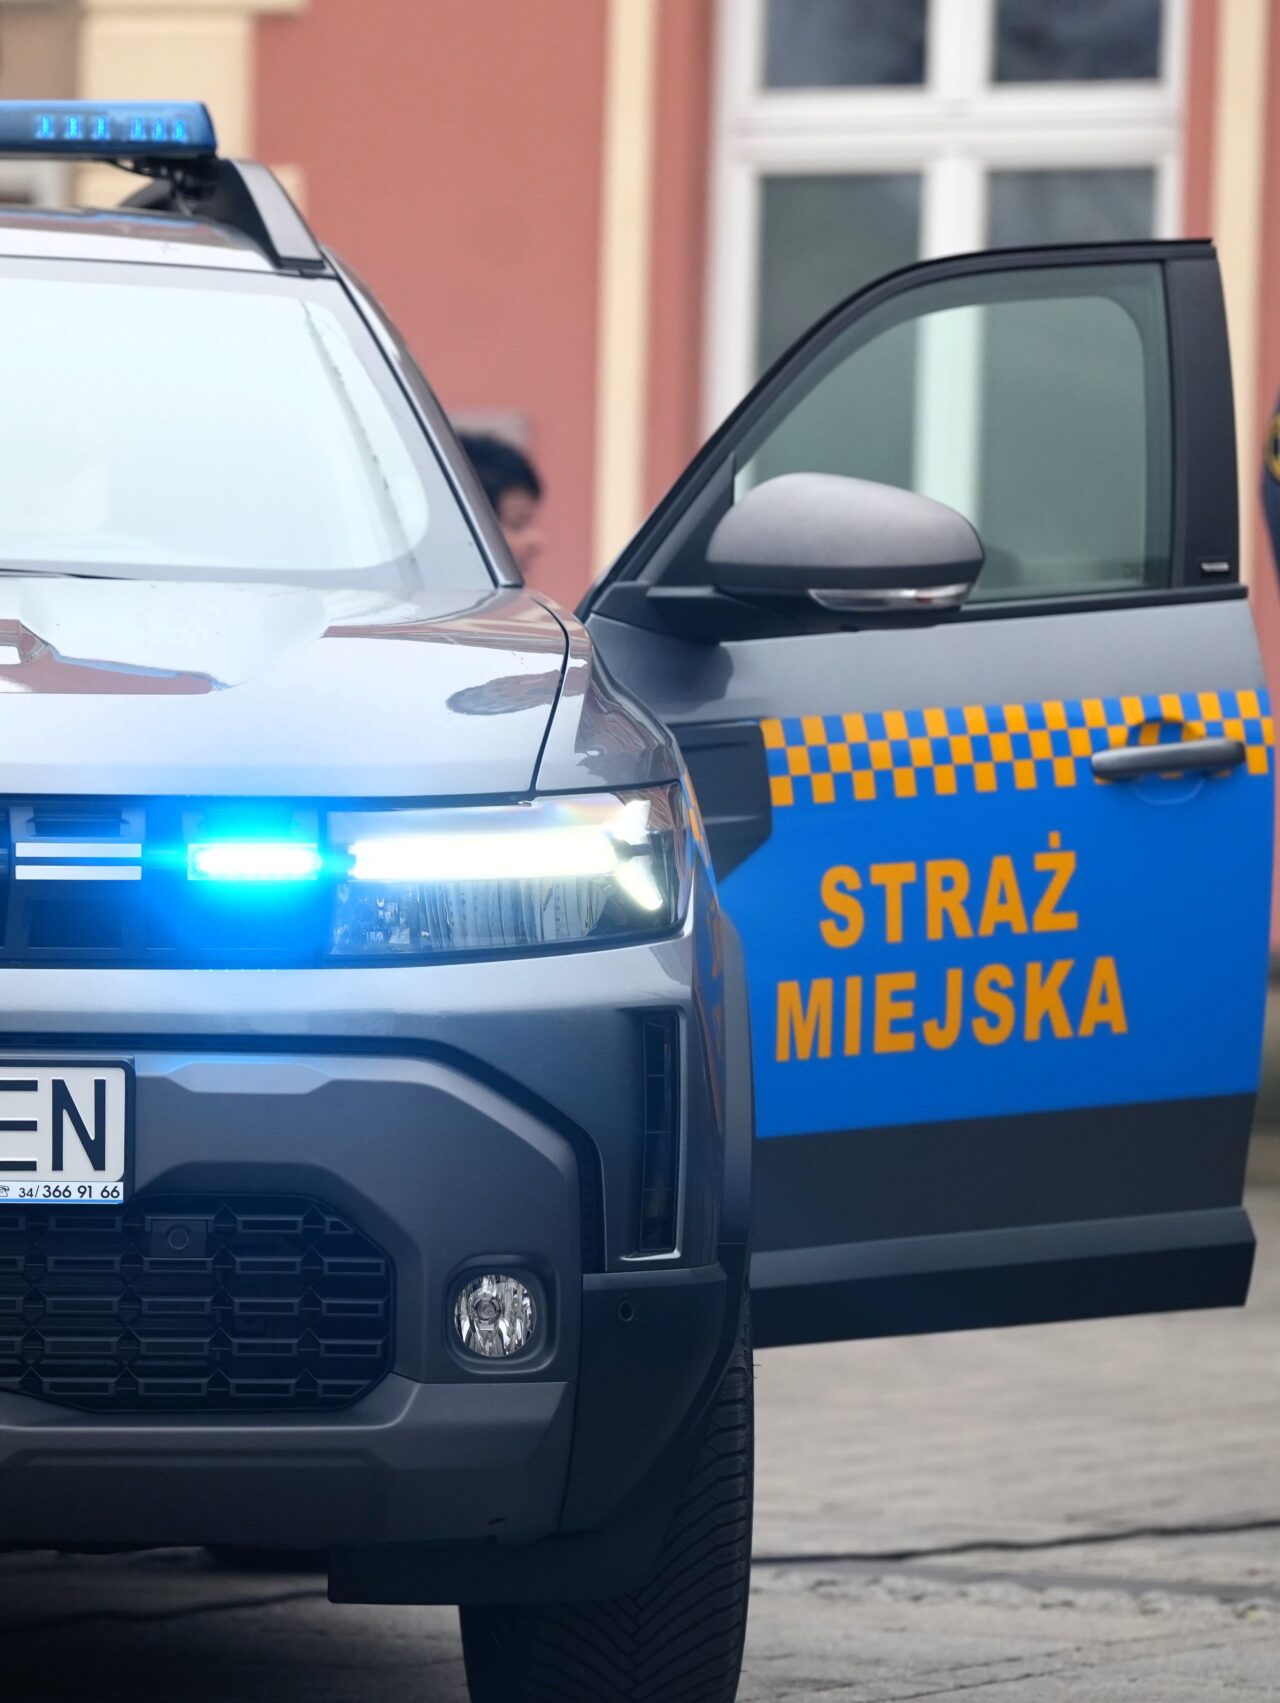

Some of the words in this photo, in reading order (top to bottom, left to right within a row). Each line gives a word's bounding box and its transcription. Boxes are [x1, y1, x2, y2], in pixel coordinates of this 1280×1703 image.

[820, 831, 1078, 948] STRAŻ
[777, 956, 1128, 1062] MIEJSKA
[77, 1185, 92, 1199] 91
[100, 1185, 120, 1199] 66
